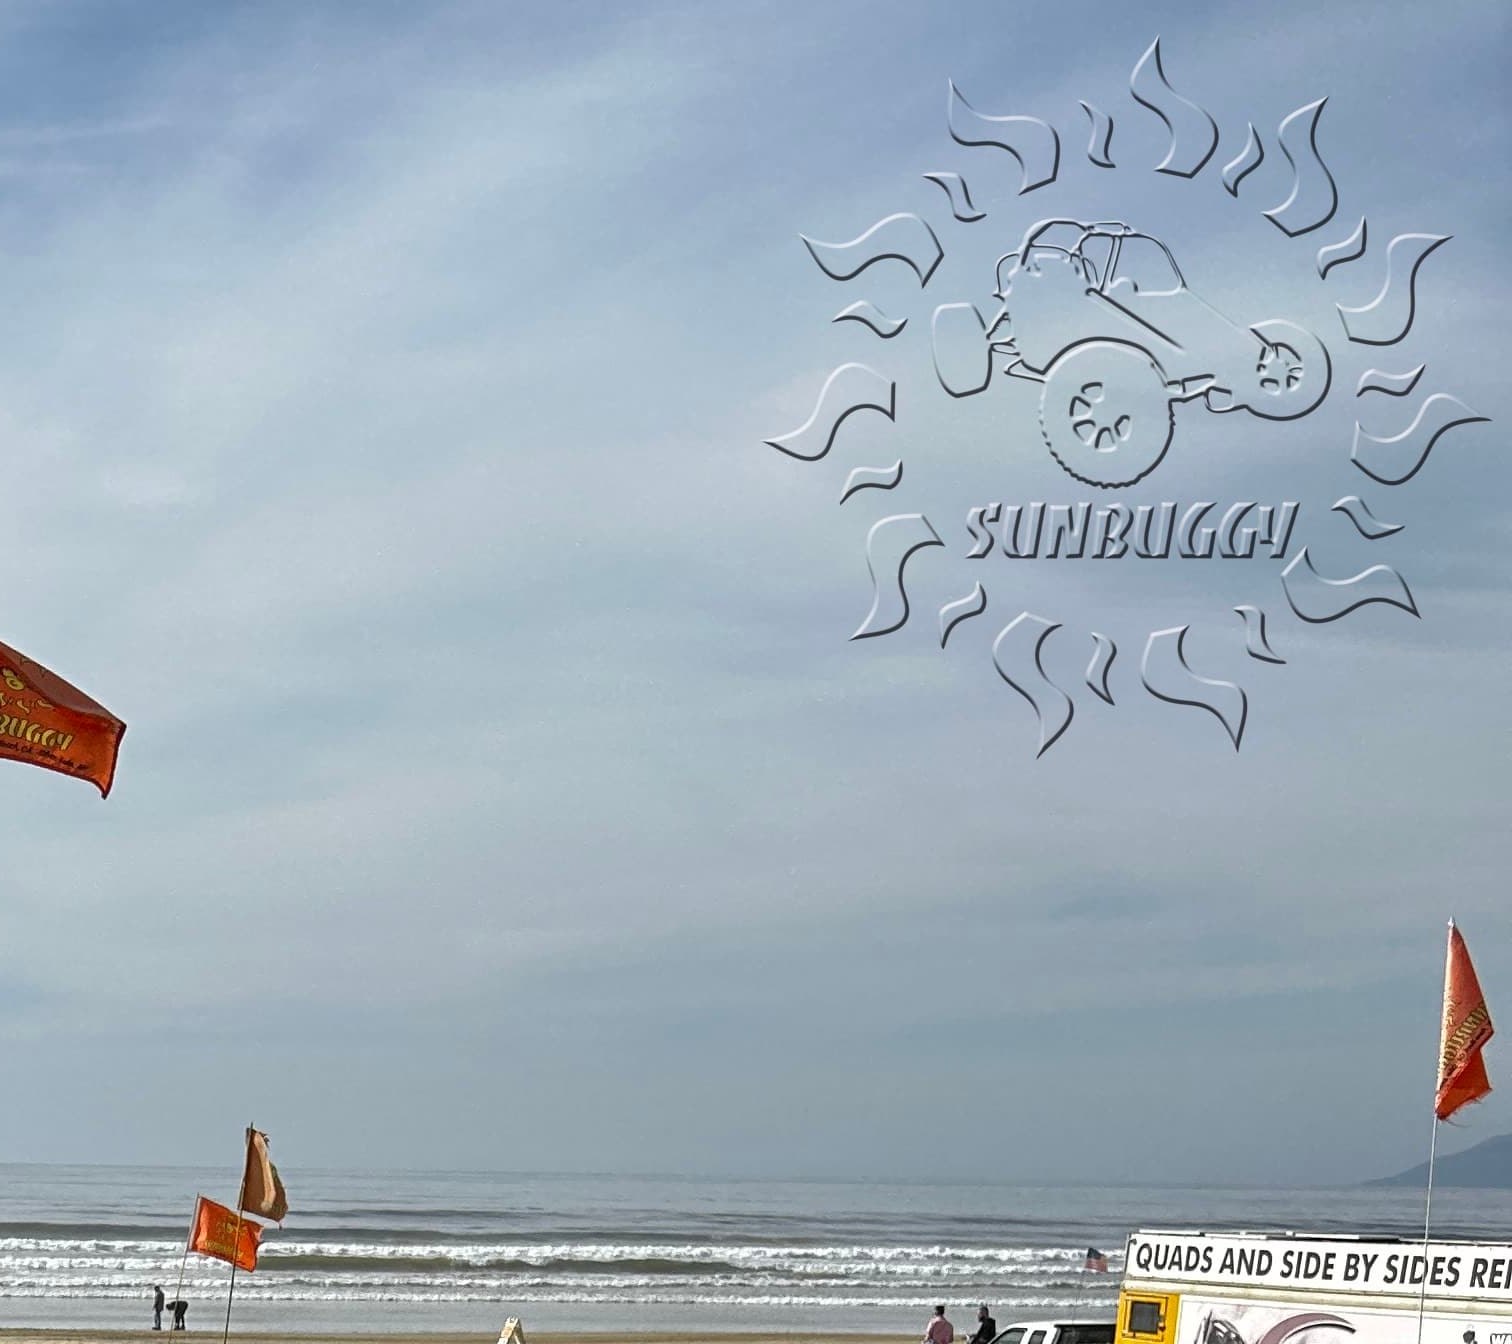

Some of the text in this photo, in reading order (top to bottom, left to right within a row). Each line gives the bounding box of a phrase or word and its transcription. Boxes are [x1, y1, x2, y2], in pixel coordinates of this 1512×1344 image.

[1136, 1243, 1213, 1273] QUADS
[1219, 1247, 1273, 1276] AND
[1280, 1250, 1336, 1281] SIDE
[1343, 1252, 1379, 1282] BY
[1383, 1254, 1462, 1287] SIDES
